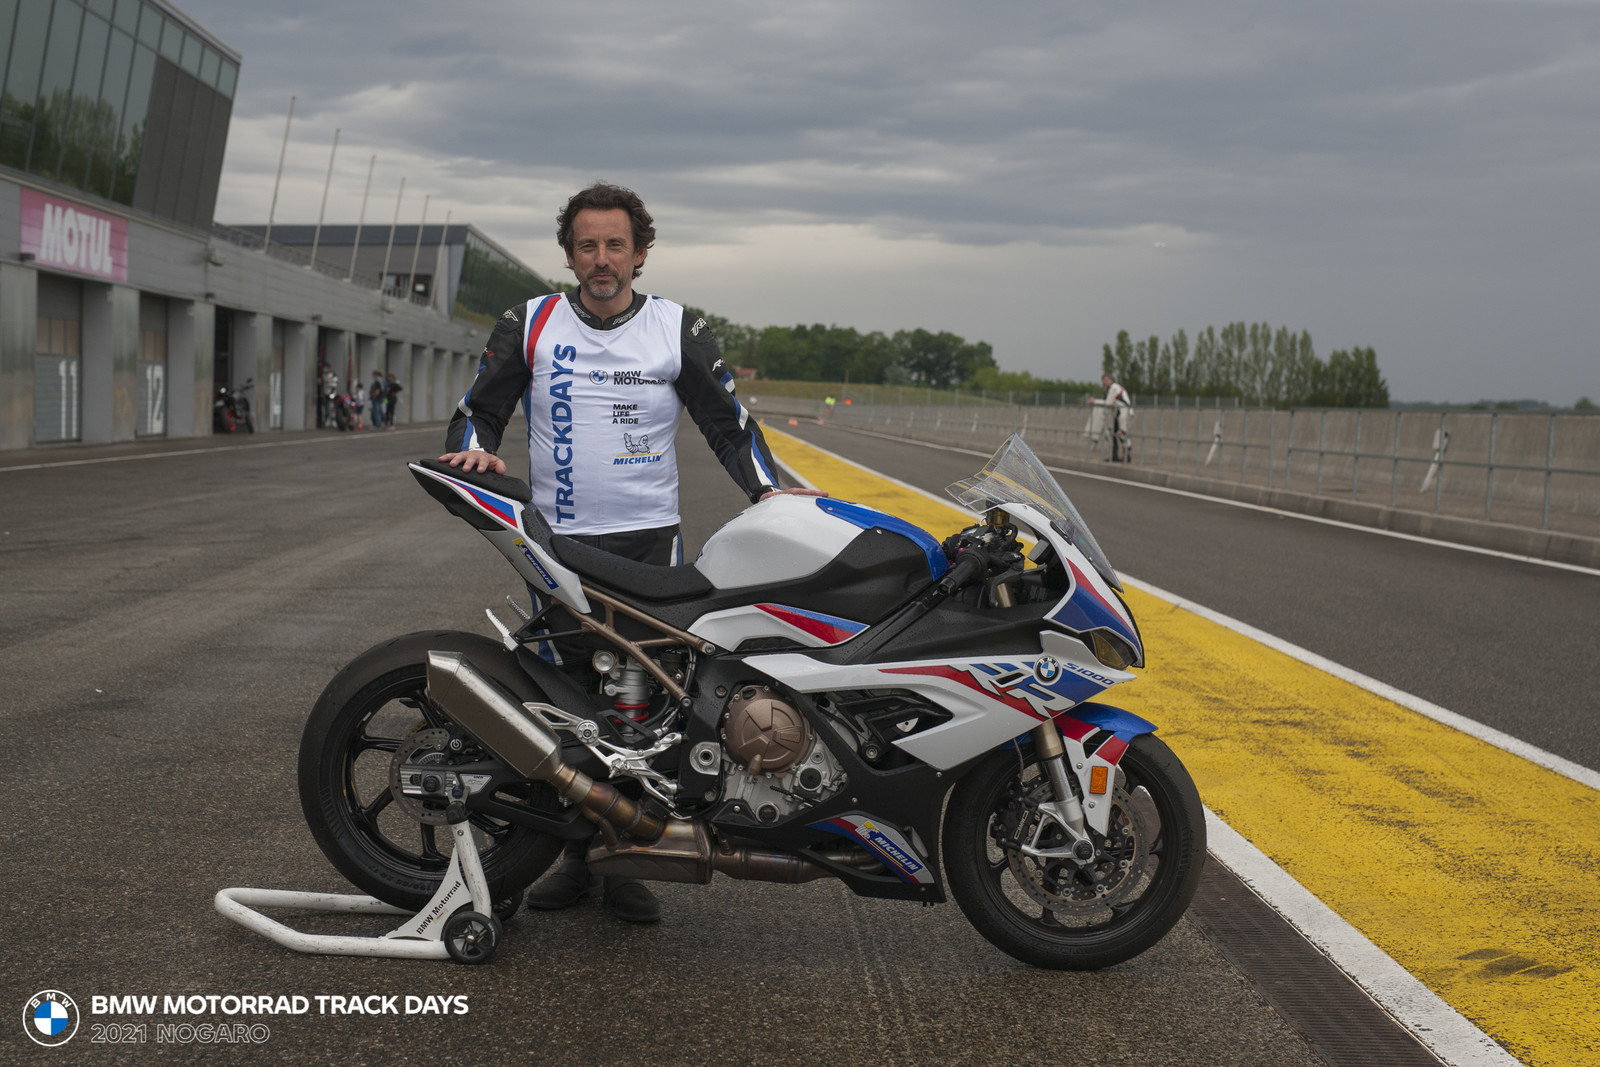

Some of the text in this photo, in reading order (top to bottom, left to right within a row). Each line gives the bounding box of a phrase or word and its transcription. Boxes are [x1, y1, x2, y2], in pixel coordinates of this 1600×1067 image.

[41, 203, 113, 274] MOTUL
[59, 360, 77, 439] 11
[146, 365, 163, 433] 12
[550, 344, 577, 524] TRACKDAYS
[613, 455, 662, 465] MICHELIN
[874, 836, 918, 871] MICHELIN
[416, 881, 461, 935] BMW Motorrad
